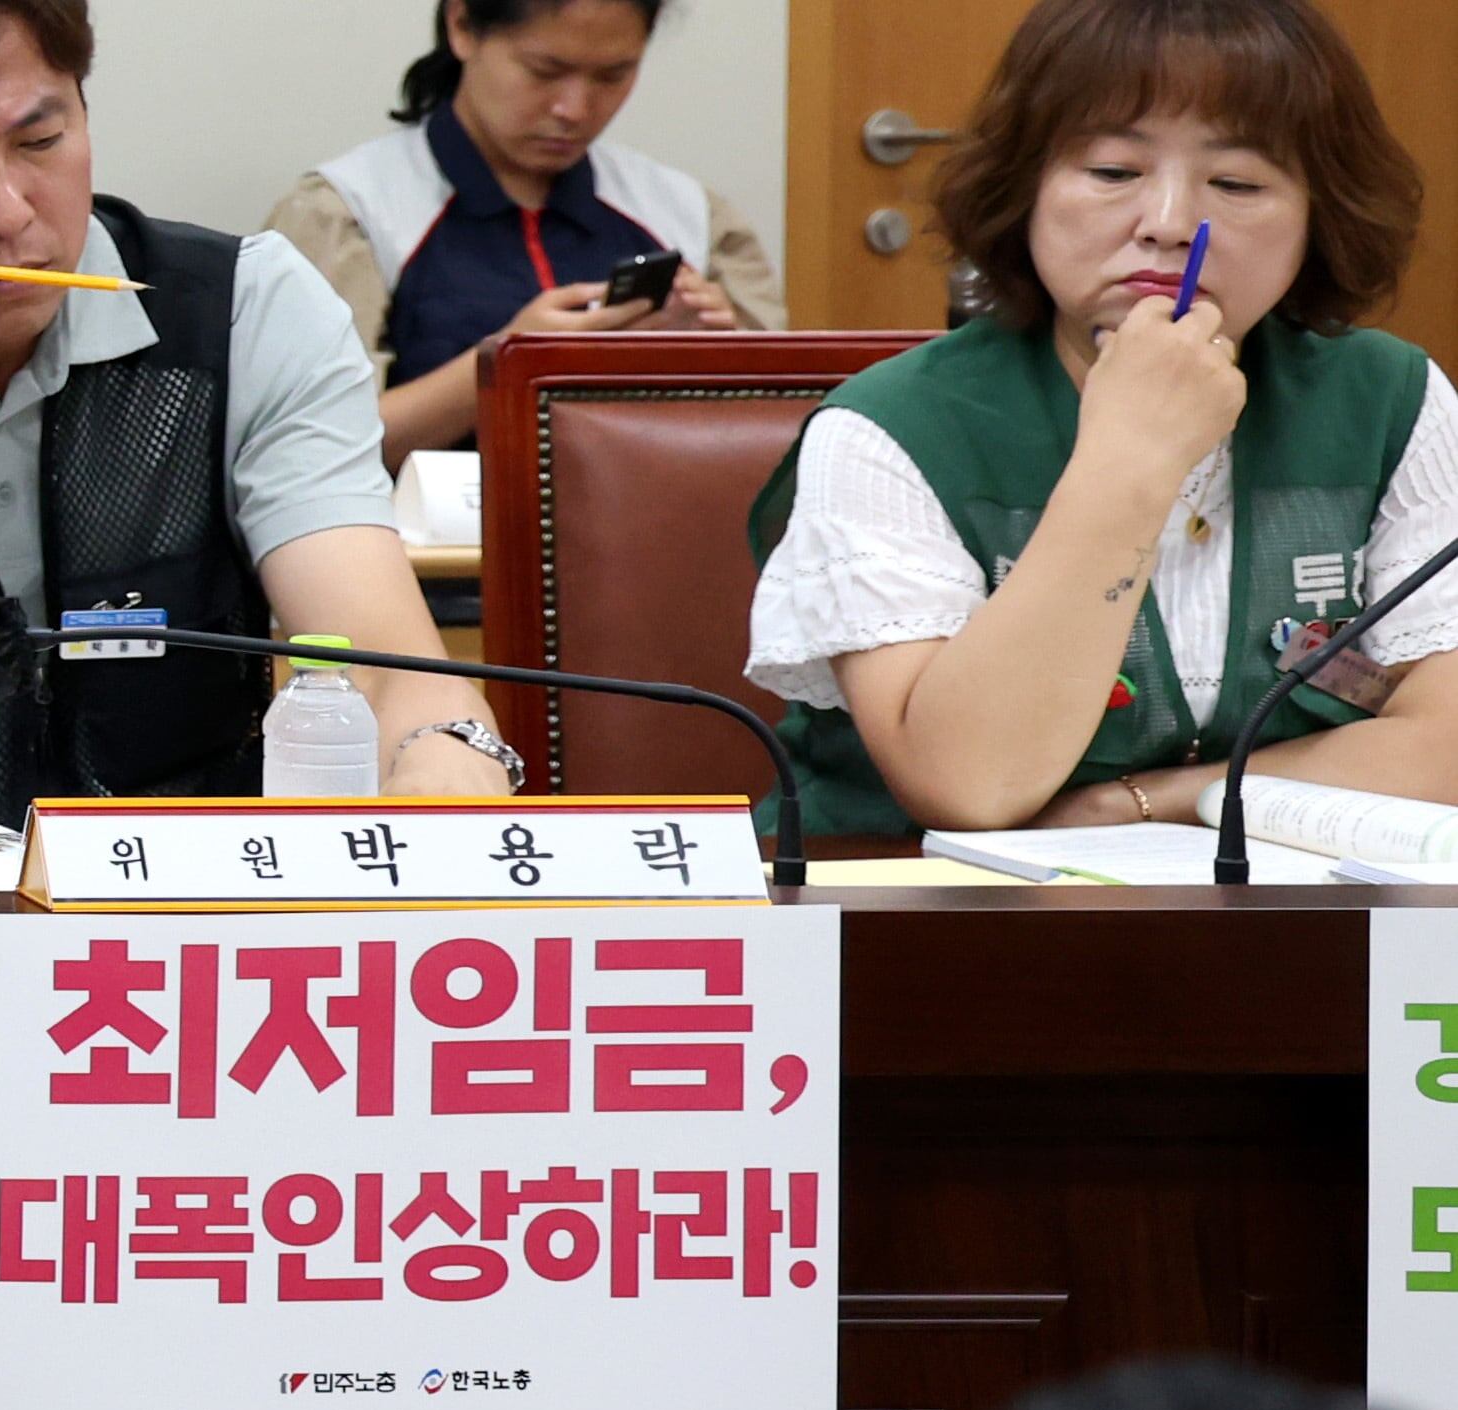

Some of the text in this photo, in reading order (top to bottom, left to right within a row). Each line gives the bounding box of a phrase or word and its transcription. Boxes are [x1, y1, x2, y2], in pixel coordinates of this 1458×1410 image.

[46, 937, 810, 1119] 최저임금,
[312, 1371, 397, 1394] 민주노총
[450, 1369, 532, 1392] 한국노총
